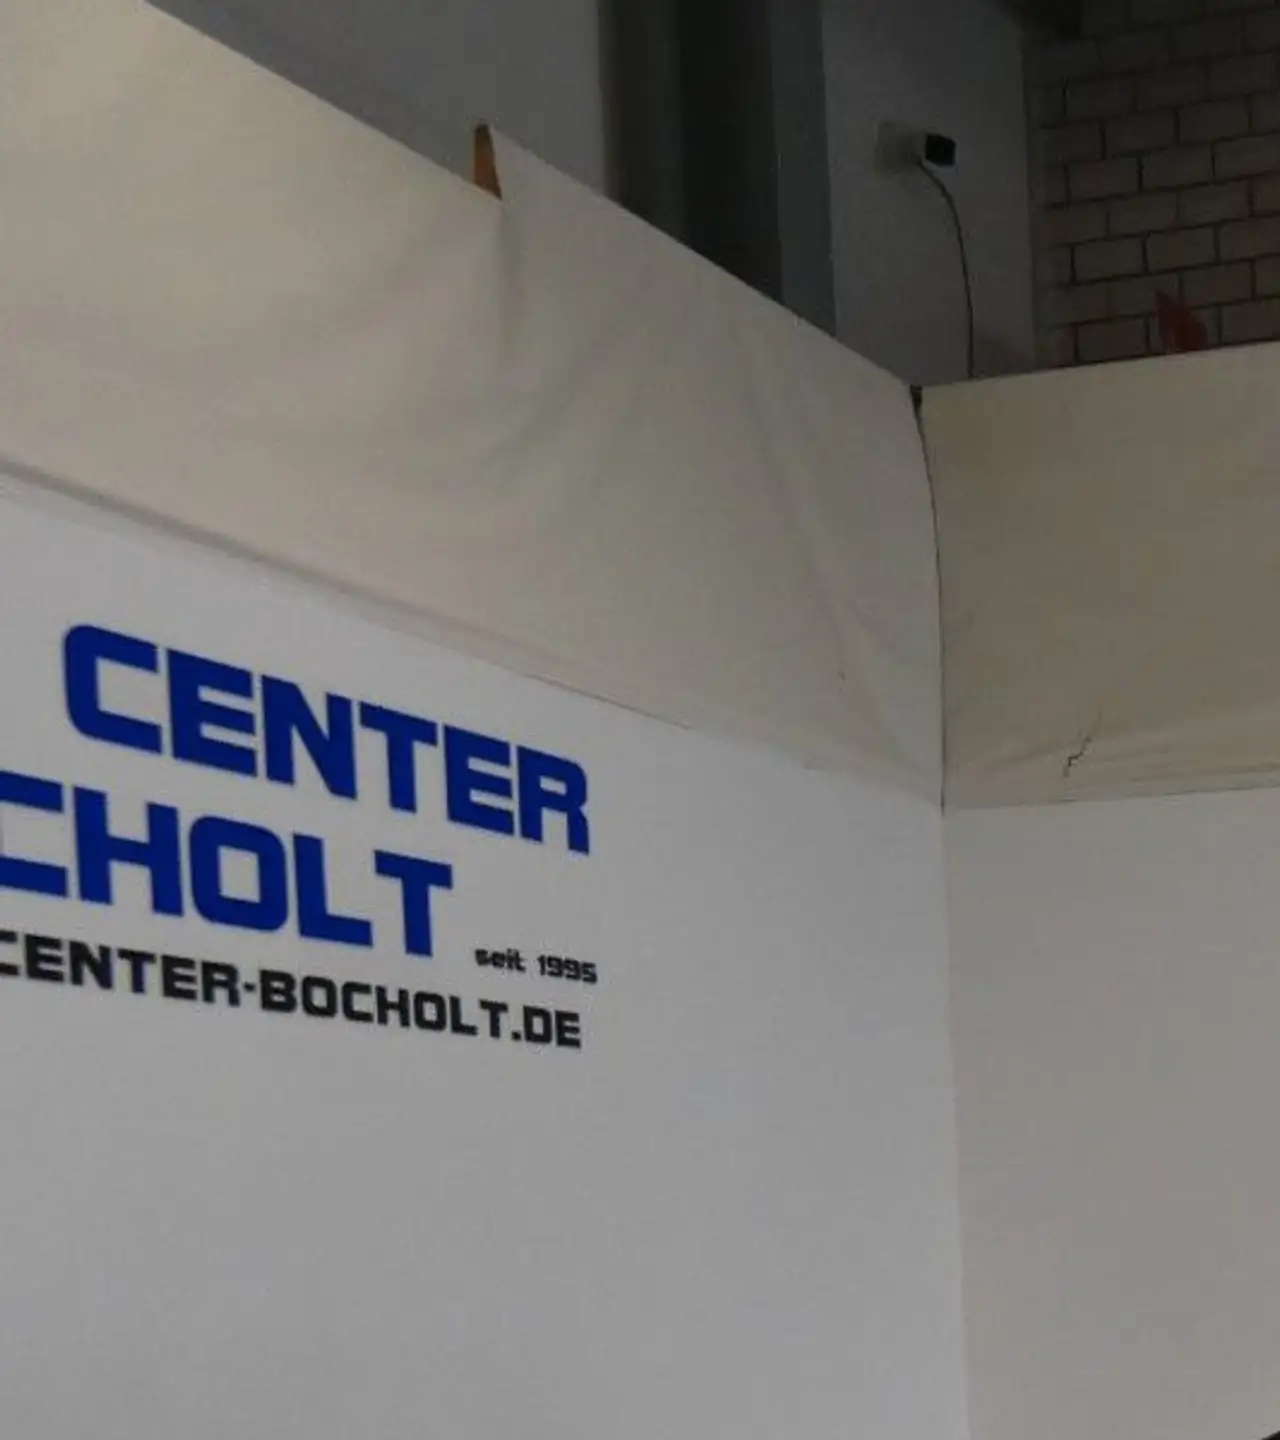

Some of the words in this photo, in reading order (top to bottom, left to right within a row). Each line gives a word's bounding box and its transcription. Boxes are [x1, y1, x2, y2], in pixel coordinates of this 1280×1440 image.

[63, 625, 589, 854] CENTER
[0, 770, 453, 957] CHOLT
[474, 946, 526, 973] seit
[536, 953, 598, 985] 1995
